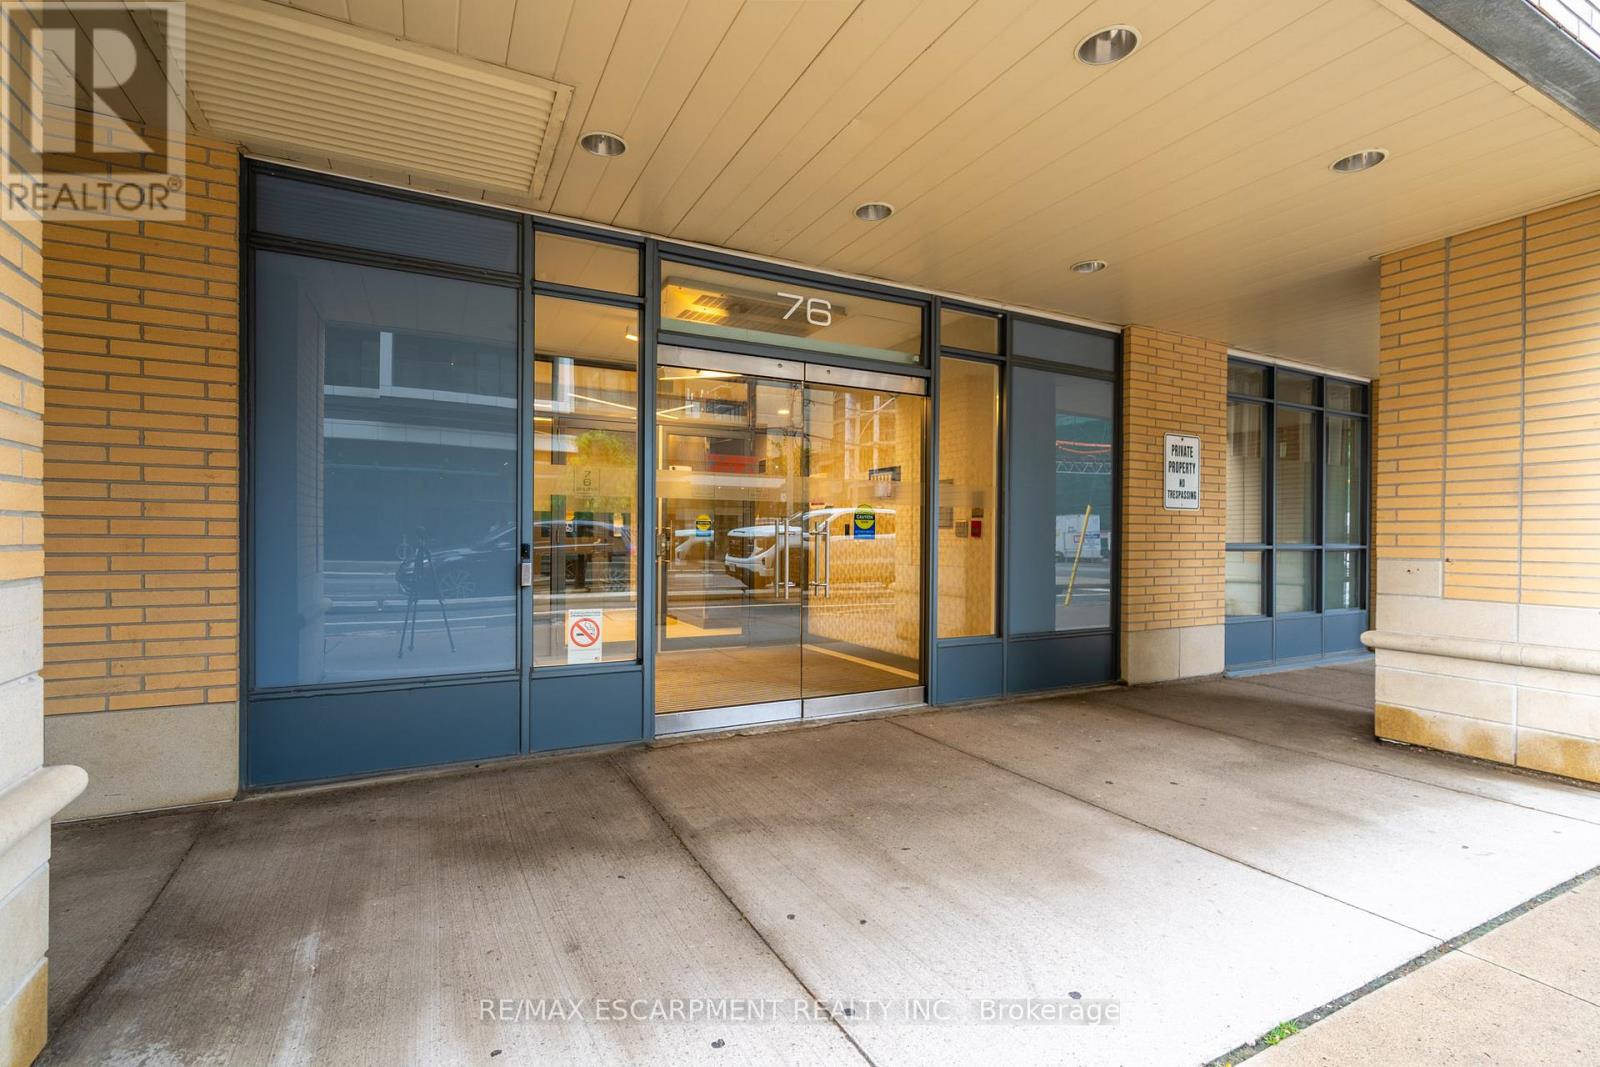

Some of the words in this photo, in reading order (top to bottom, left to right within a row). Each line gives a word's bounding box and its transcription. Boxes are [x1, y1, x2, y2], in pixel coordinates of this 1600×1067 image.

[777, 292, 831, 327] 76
[1171, 445, 1193, 458] PRIVATE
[1168, 461, 1196, 474] PROPERTY
[1179, 479, 1185, 487] NO
[1168, 490, 1197, 500] TRESPASSING
